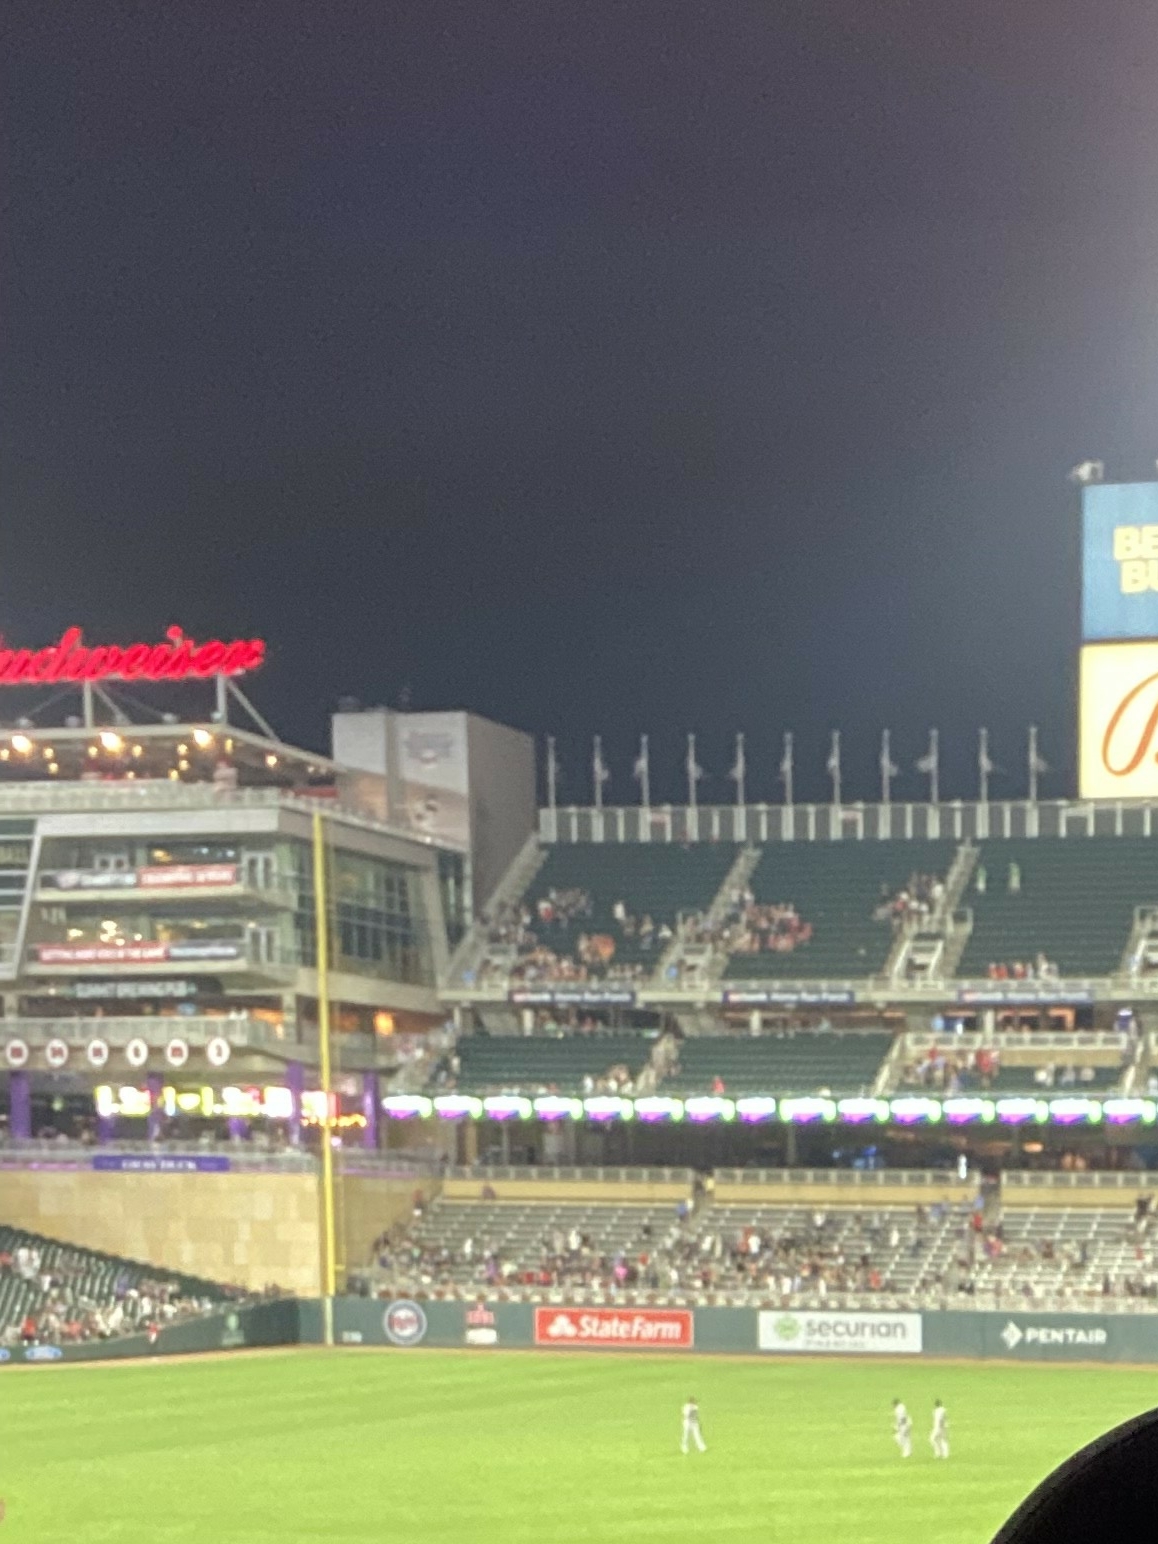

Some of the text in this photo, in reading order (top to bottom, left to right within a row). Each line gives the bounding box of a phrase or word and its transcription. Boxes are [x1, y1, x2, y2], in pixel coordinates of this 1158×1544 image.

[0, 624, 265, 685] udweiser
[805, 1317, 907, 1339] securian
[1026, 1327, 1107, 1345] PENTAIR
